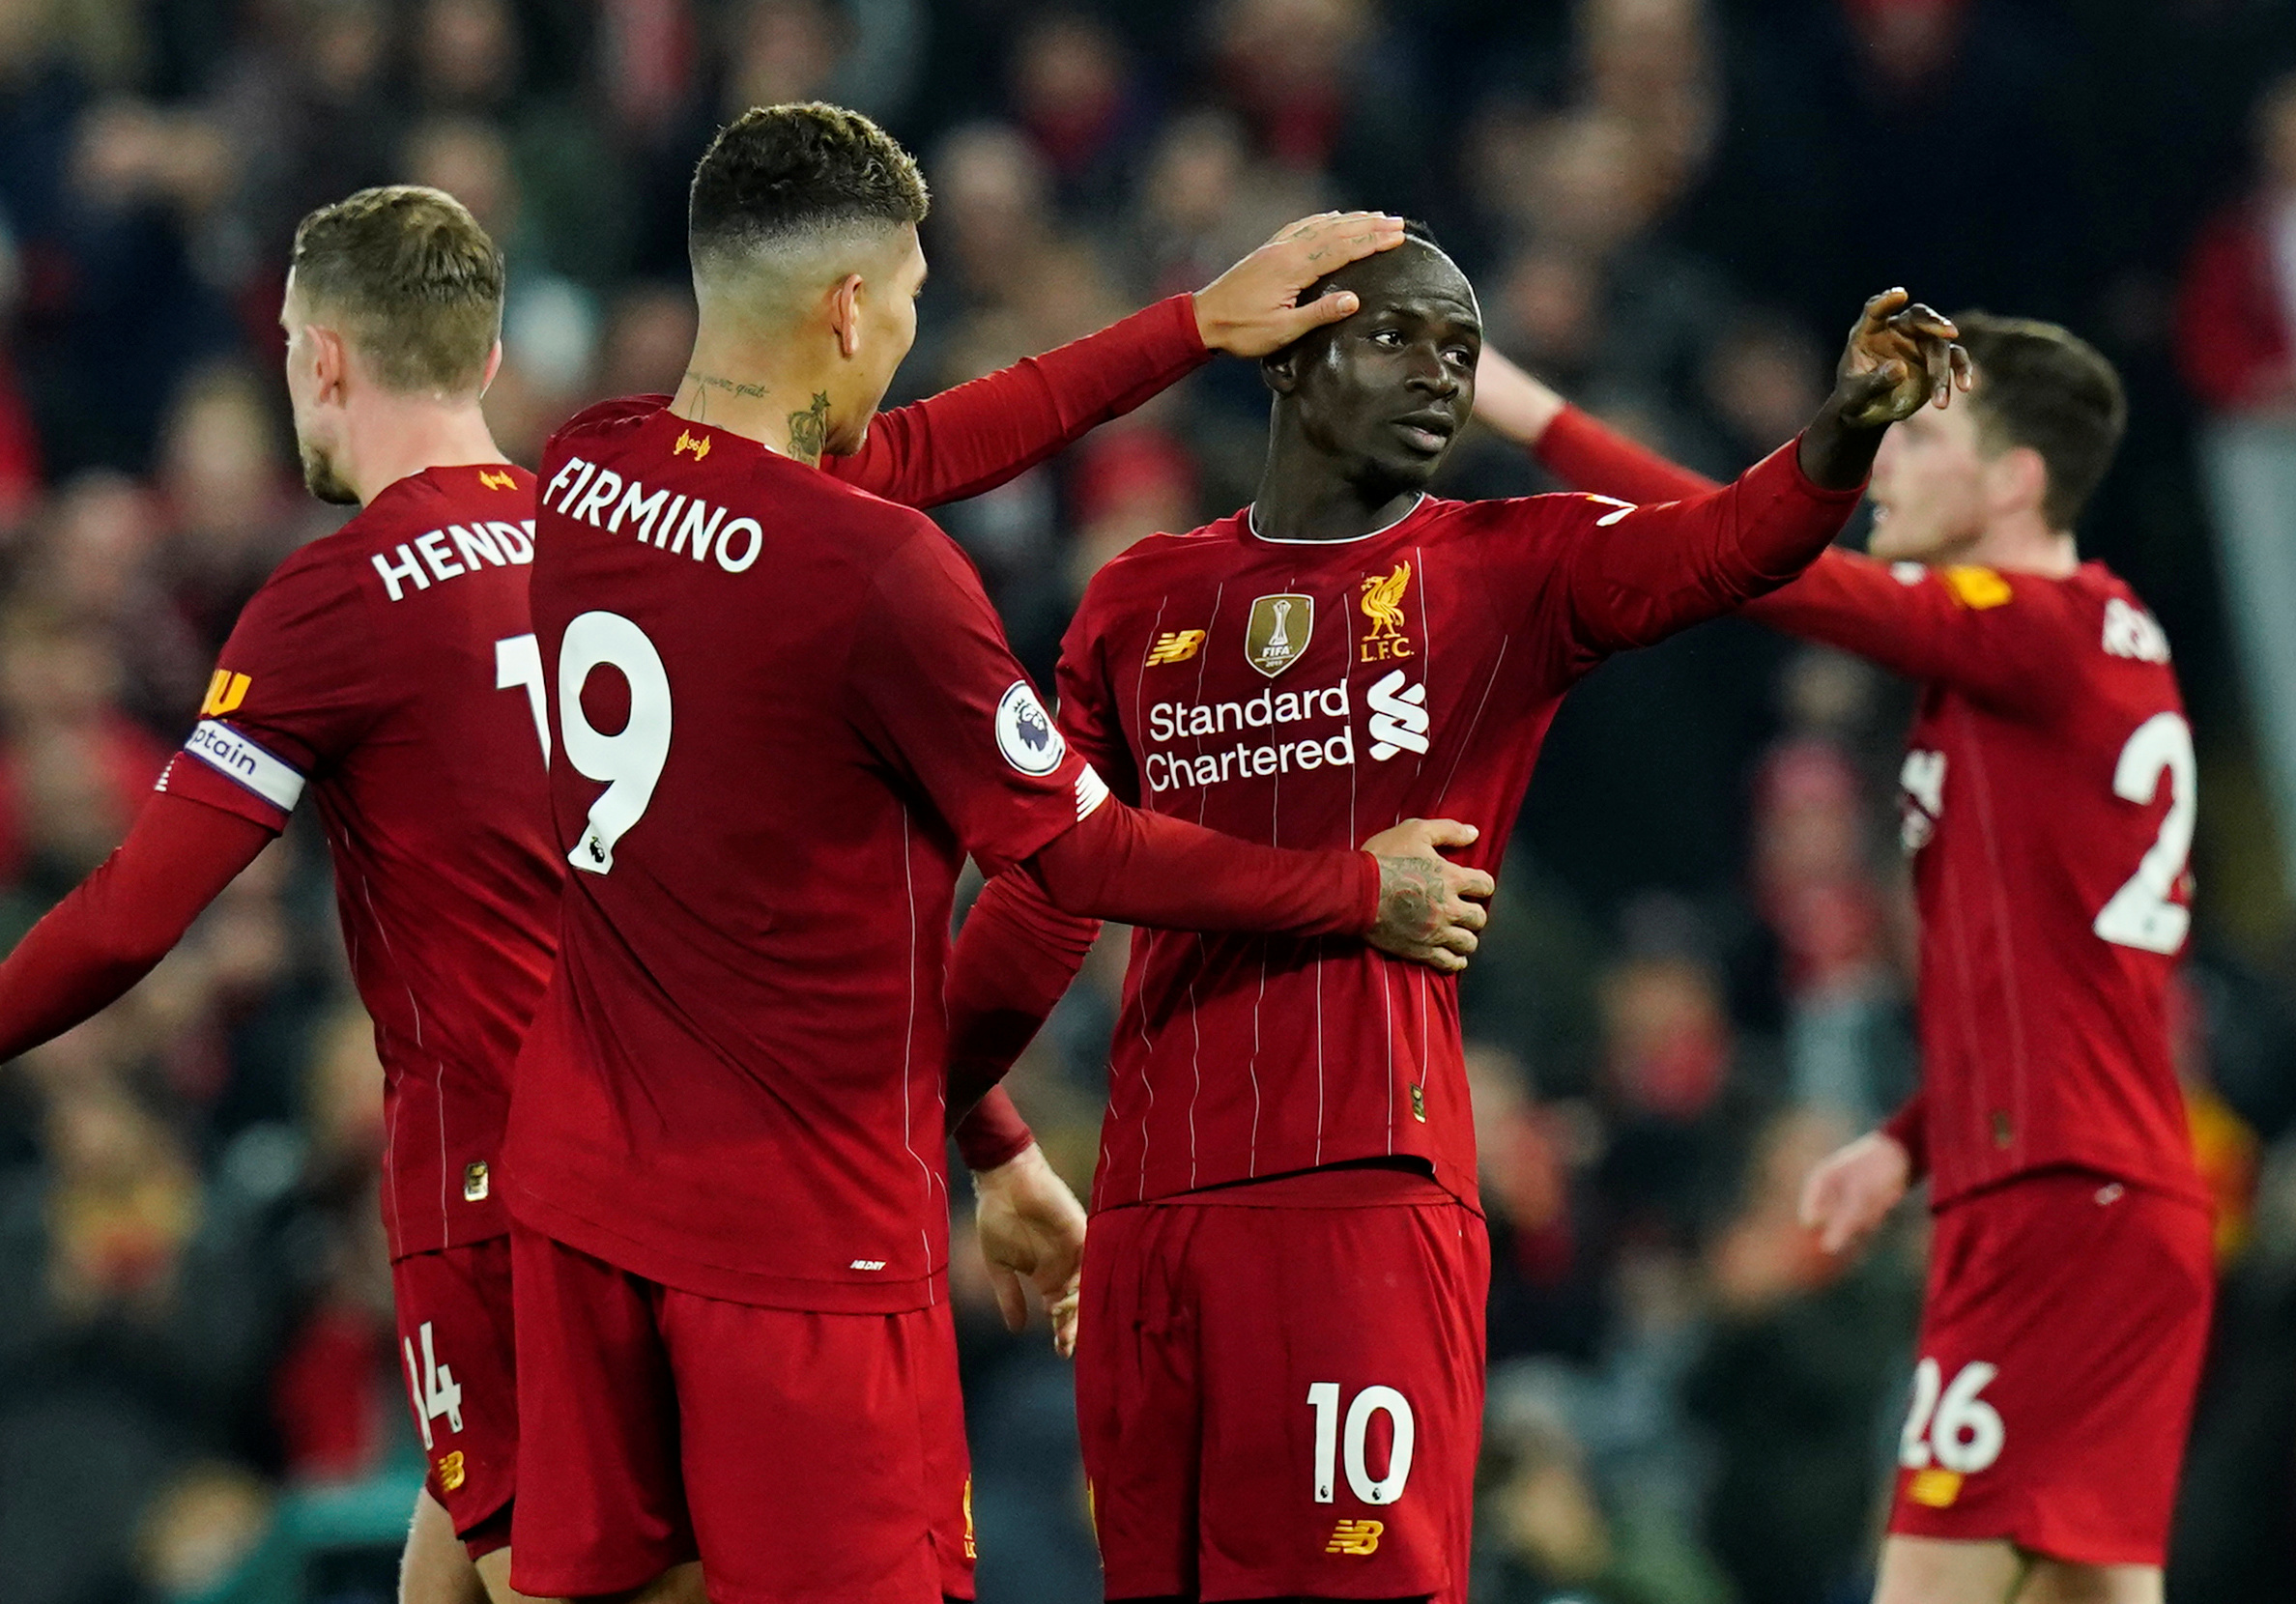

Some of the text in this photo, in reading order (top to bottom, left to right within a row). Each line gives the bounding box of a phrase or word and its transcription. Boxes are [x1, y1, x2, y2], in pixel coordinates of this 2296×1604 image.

[687, 438, 701, 451] 96
[371, 519, 536, 602] HEND
[543, 456, 763, 574] FIRMINO
[1262, 645, 1290, 658] FIFA
[559, 611, 673, 874] 9
[1146, 725, 1356, 792] Chartered
[1150, 677, 1350, 742] Standard
[404, 1321, 464, 1450] 14
[1898, 1357, 2006, 1475] 26
[1306, 1382, 1415, 1504] 10
